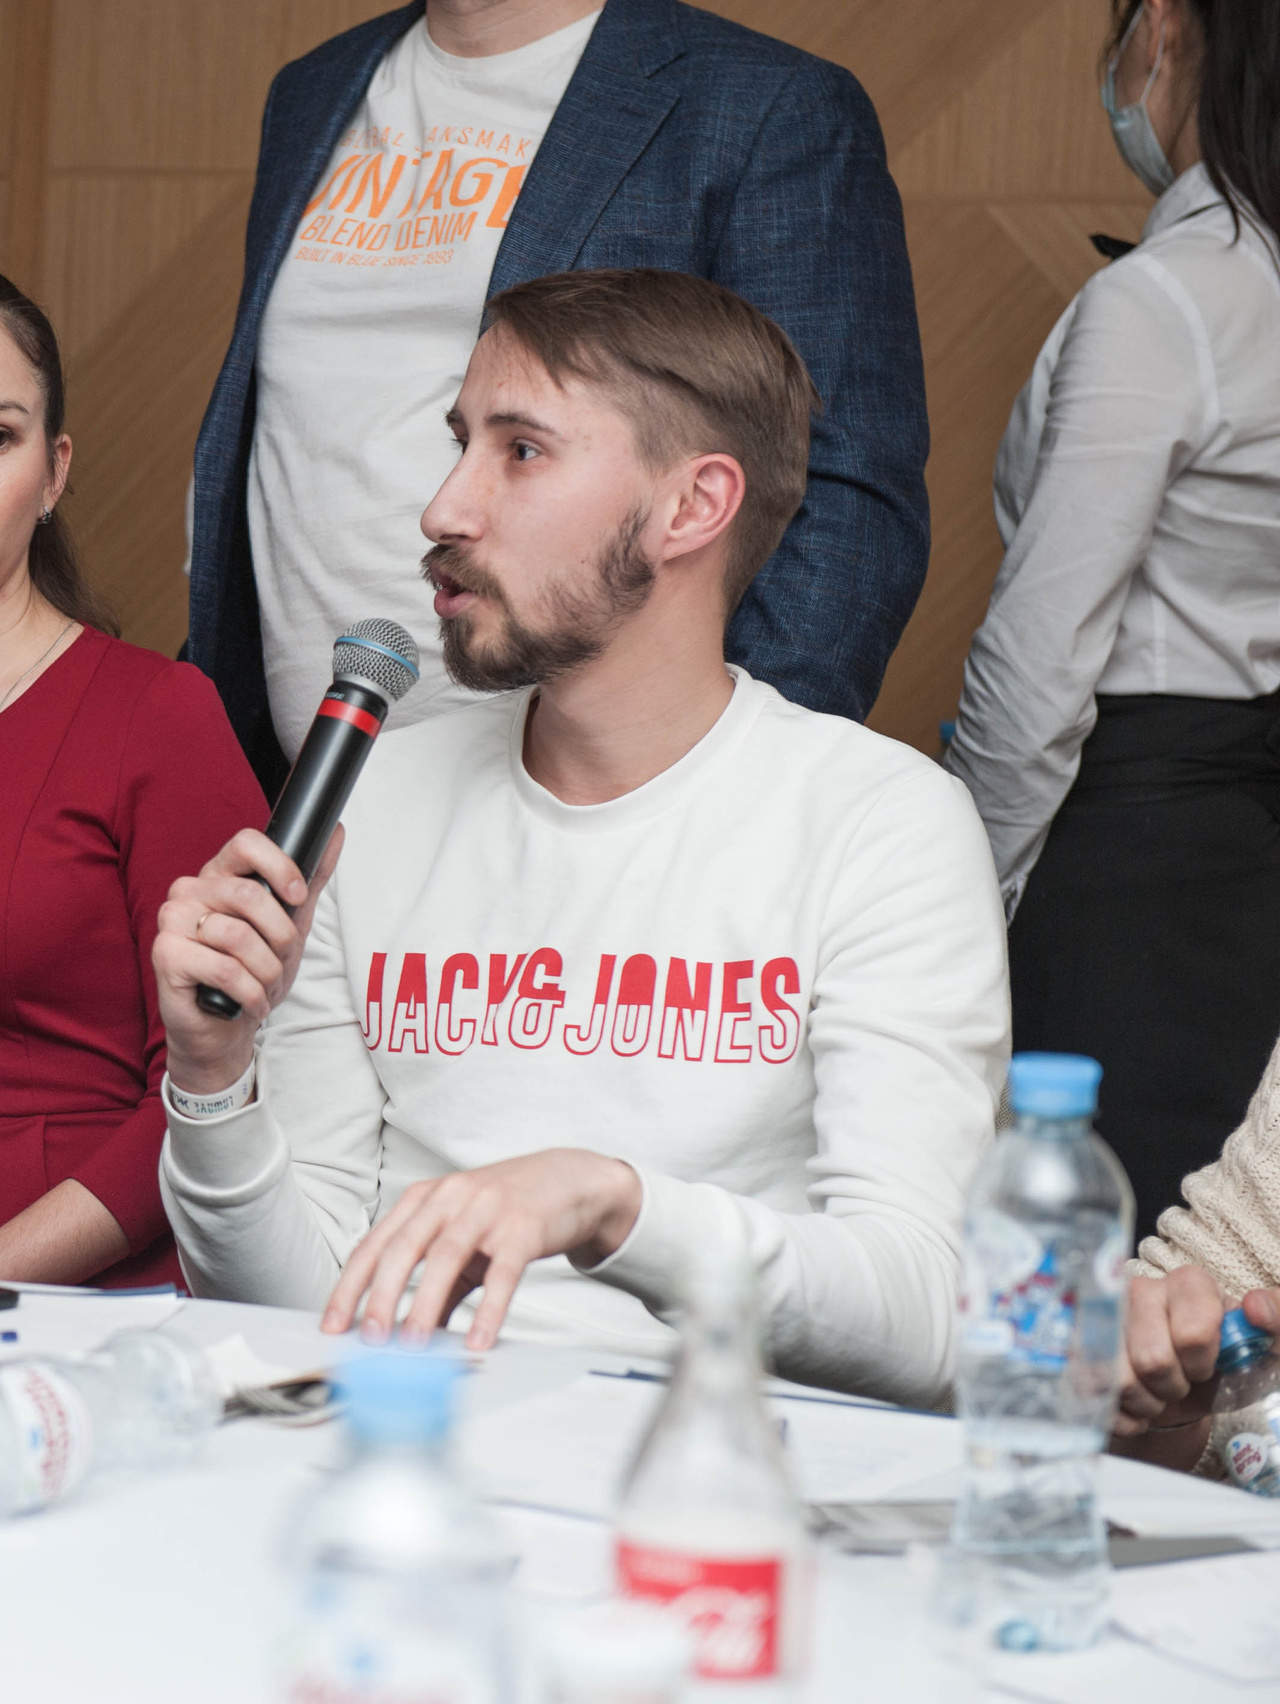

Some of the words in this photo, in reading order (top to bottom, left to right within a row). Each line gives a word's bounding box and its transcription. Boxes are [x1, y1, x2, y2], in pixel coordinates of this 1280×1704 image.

[299, 215, 392, 251] BLEND
[394, 211, 479, 252] DENIM
[294, 246, 331, 263] BUILT
[346, 251, 381, 267] BLUE
